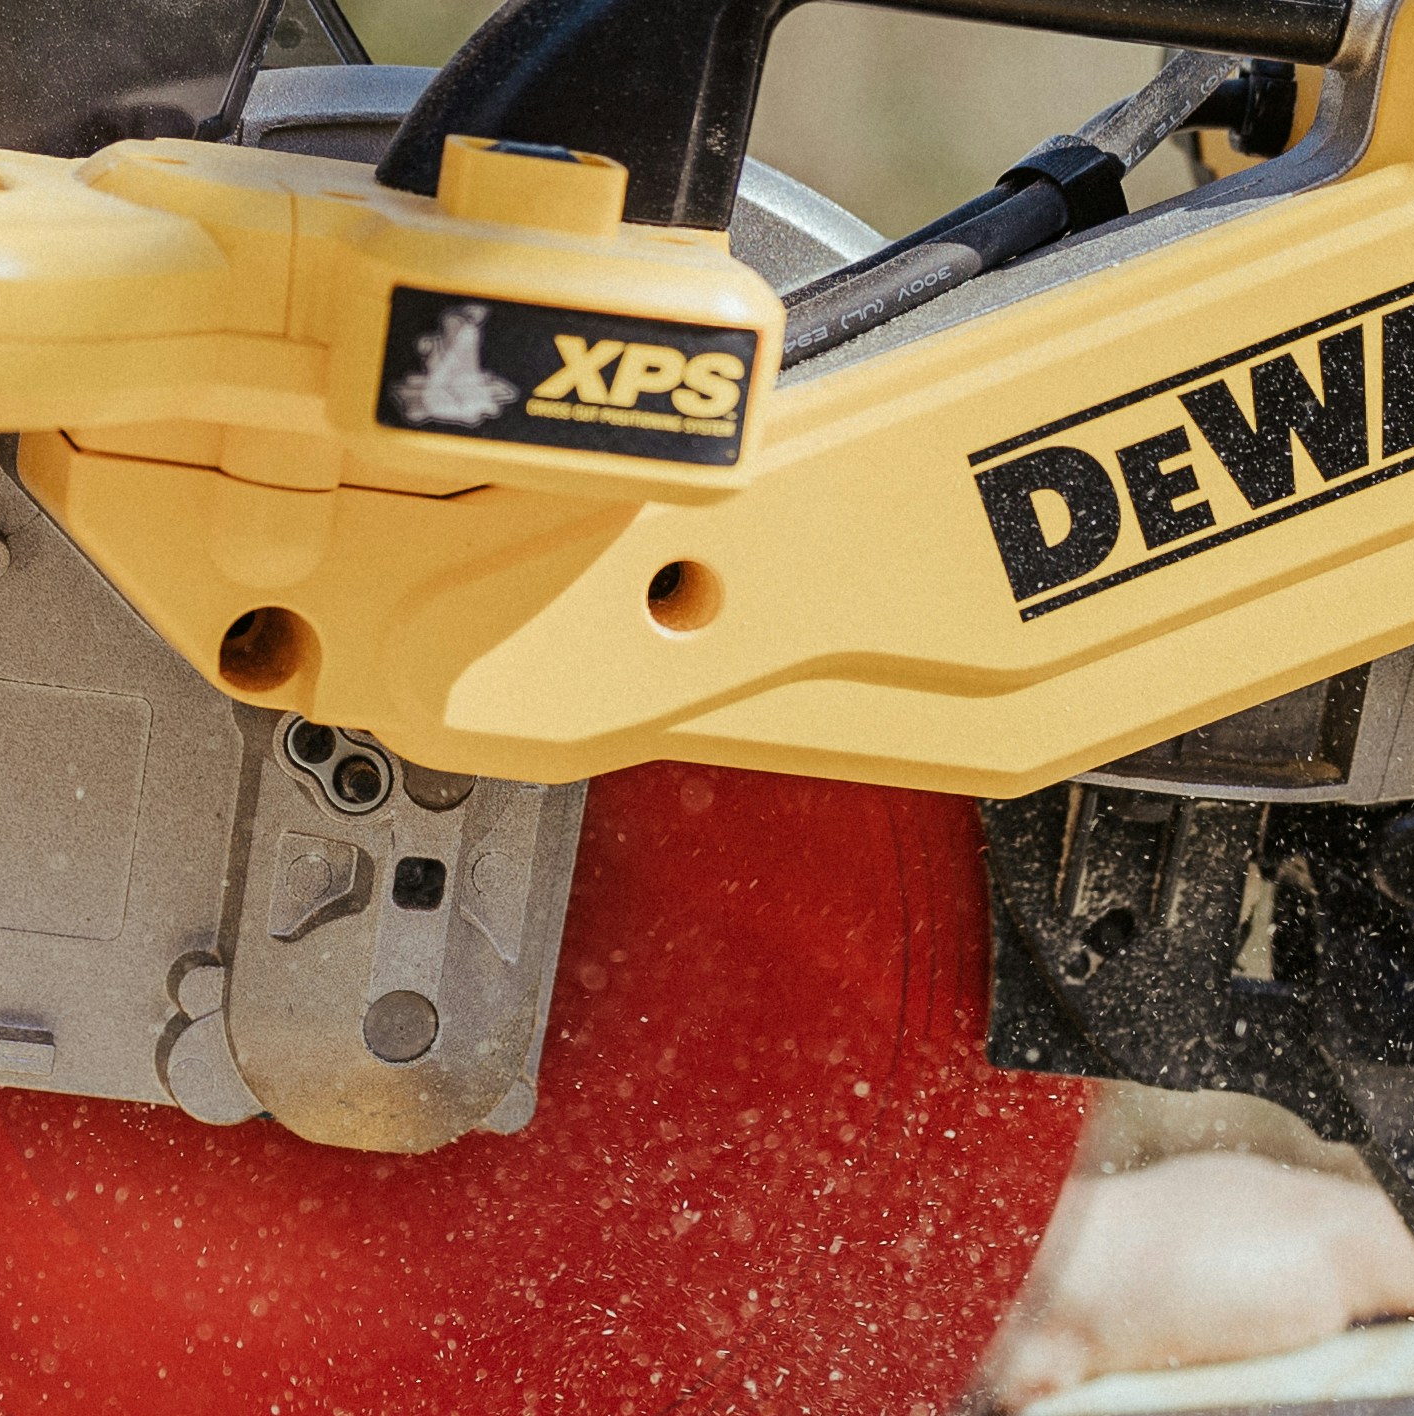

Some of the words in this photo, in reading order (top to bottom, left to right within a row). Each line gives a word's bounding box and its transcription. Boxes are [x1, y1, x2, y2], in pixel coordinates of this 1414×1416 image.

[1154, 100, 1193, 139] FT2
[898, 265, 952, 301] 300V
[840, 298, 884, 330] (UL)
[532, 334, 746, 418] XPS
